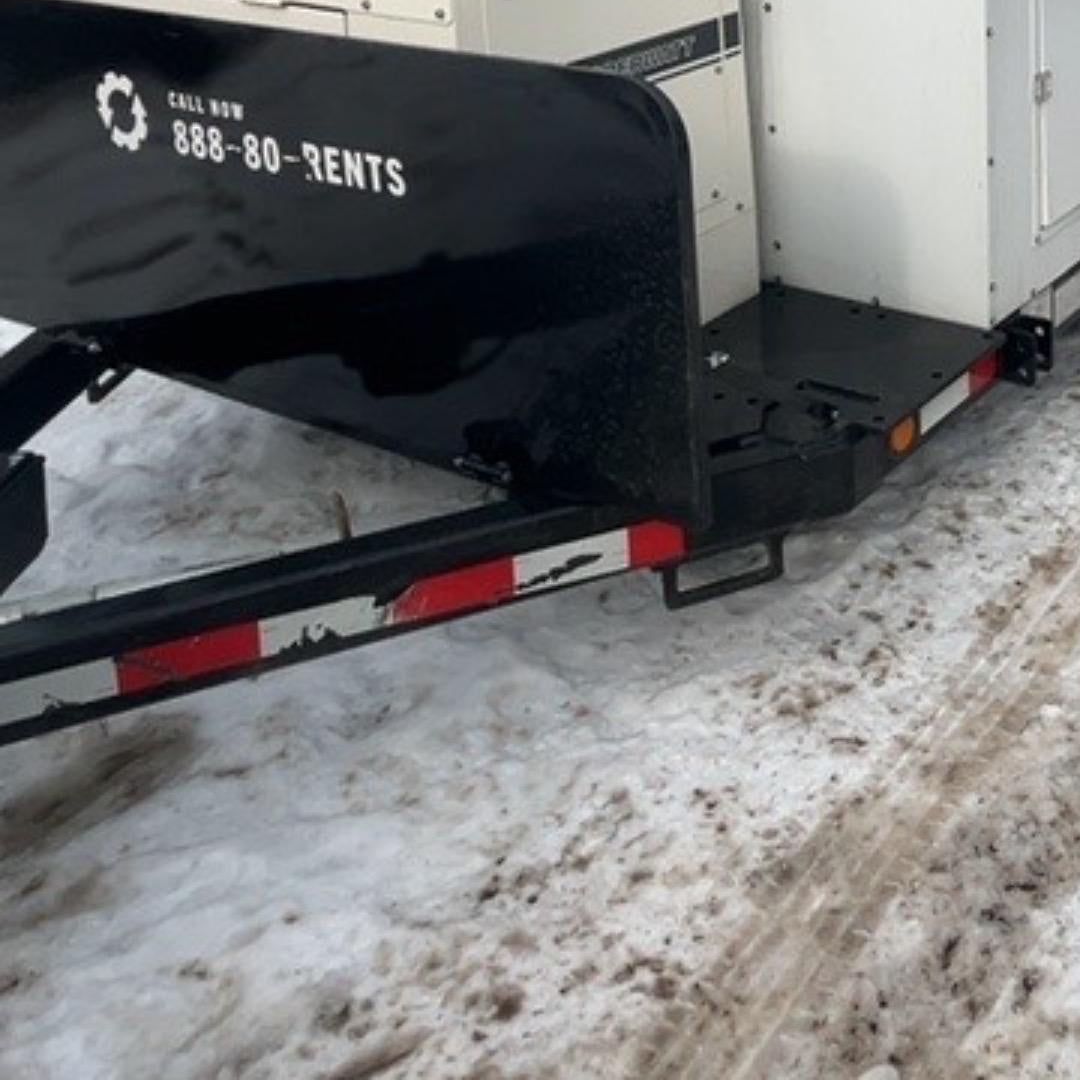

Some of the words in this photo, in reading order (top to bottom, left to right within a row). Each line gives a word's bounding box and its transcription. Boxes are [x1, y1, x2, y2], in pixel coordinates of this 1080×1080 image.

[167, 89, 205, 115] CALL
[209, 97, 245, 121] NOW
[172, 119, 407, 197] 888-80-RENTS
